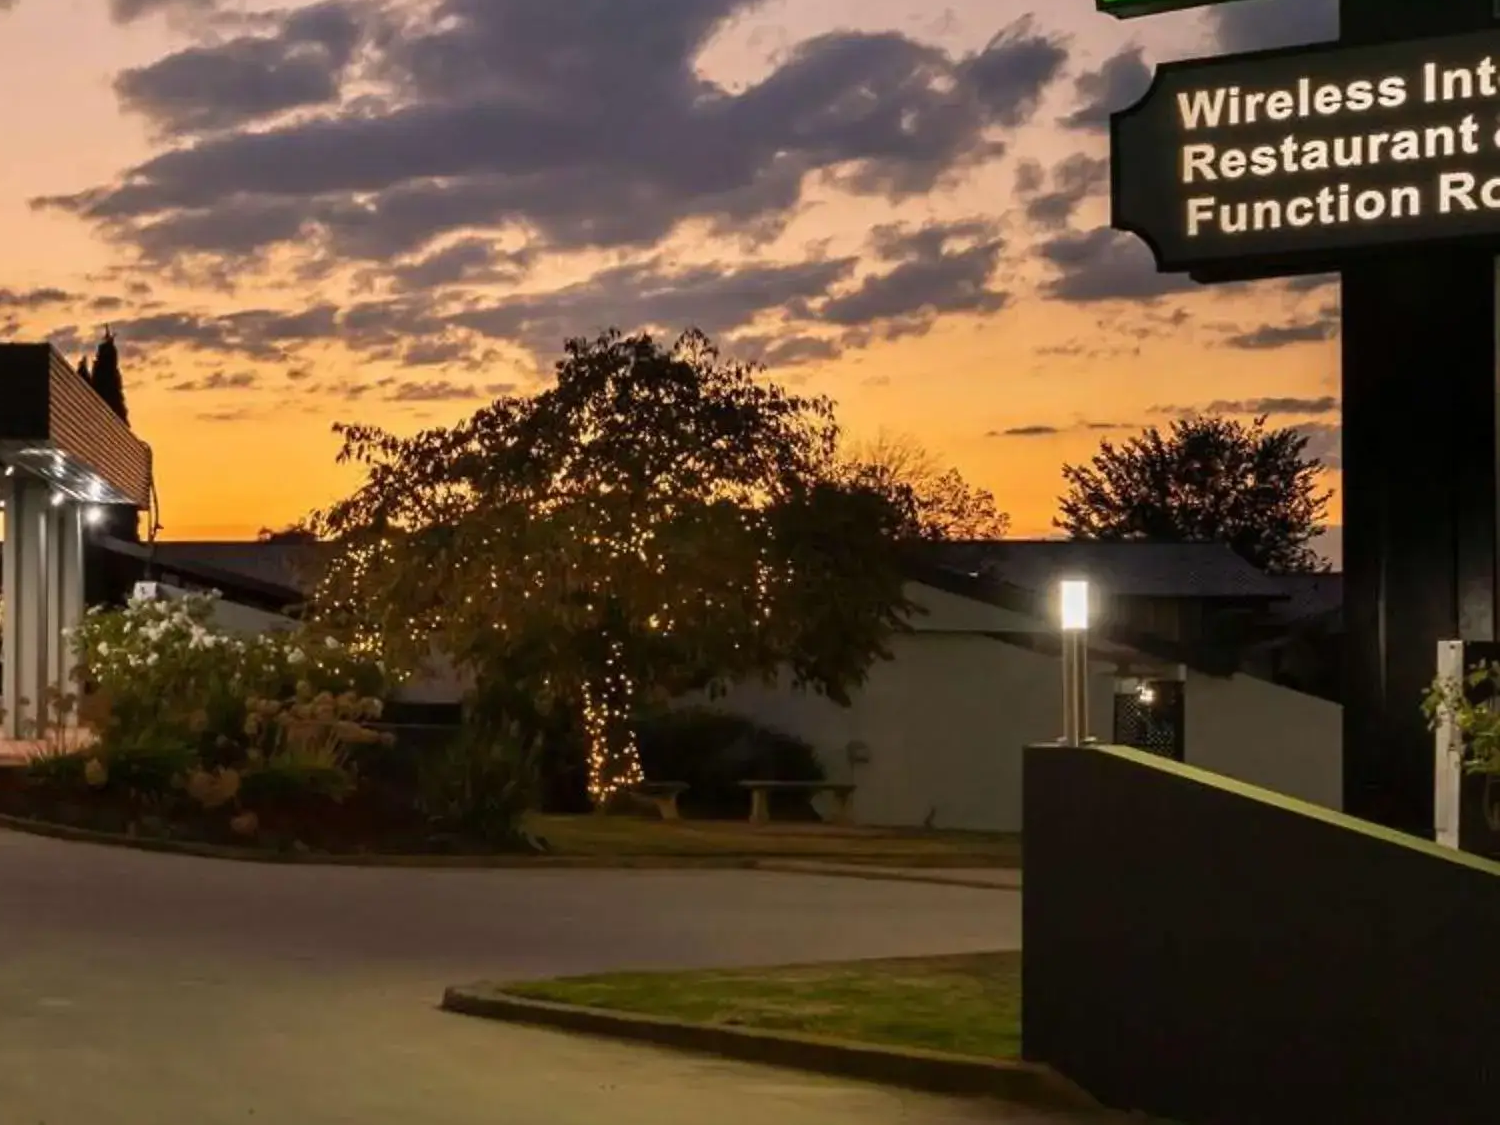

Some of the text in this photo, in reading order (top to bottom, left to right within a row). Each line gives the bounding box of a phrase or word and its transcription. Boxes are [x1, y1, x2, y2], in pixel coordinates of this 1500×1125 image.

[1176, 55, 1500, 131] Wireless Int
[1181, 113, 1480, 184] Restaurant
[1186, 183, 1420, 237] Function
